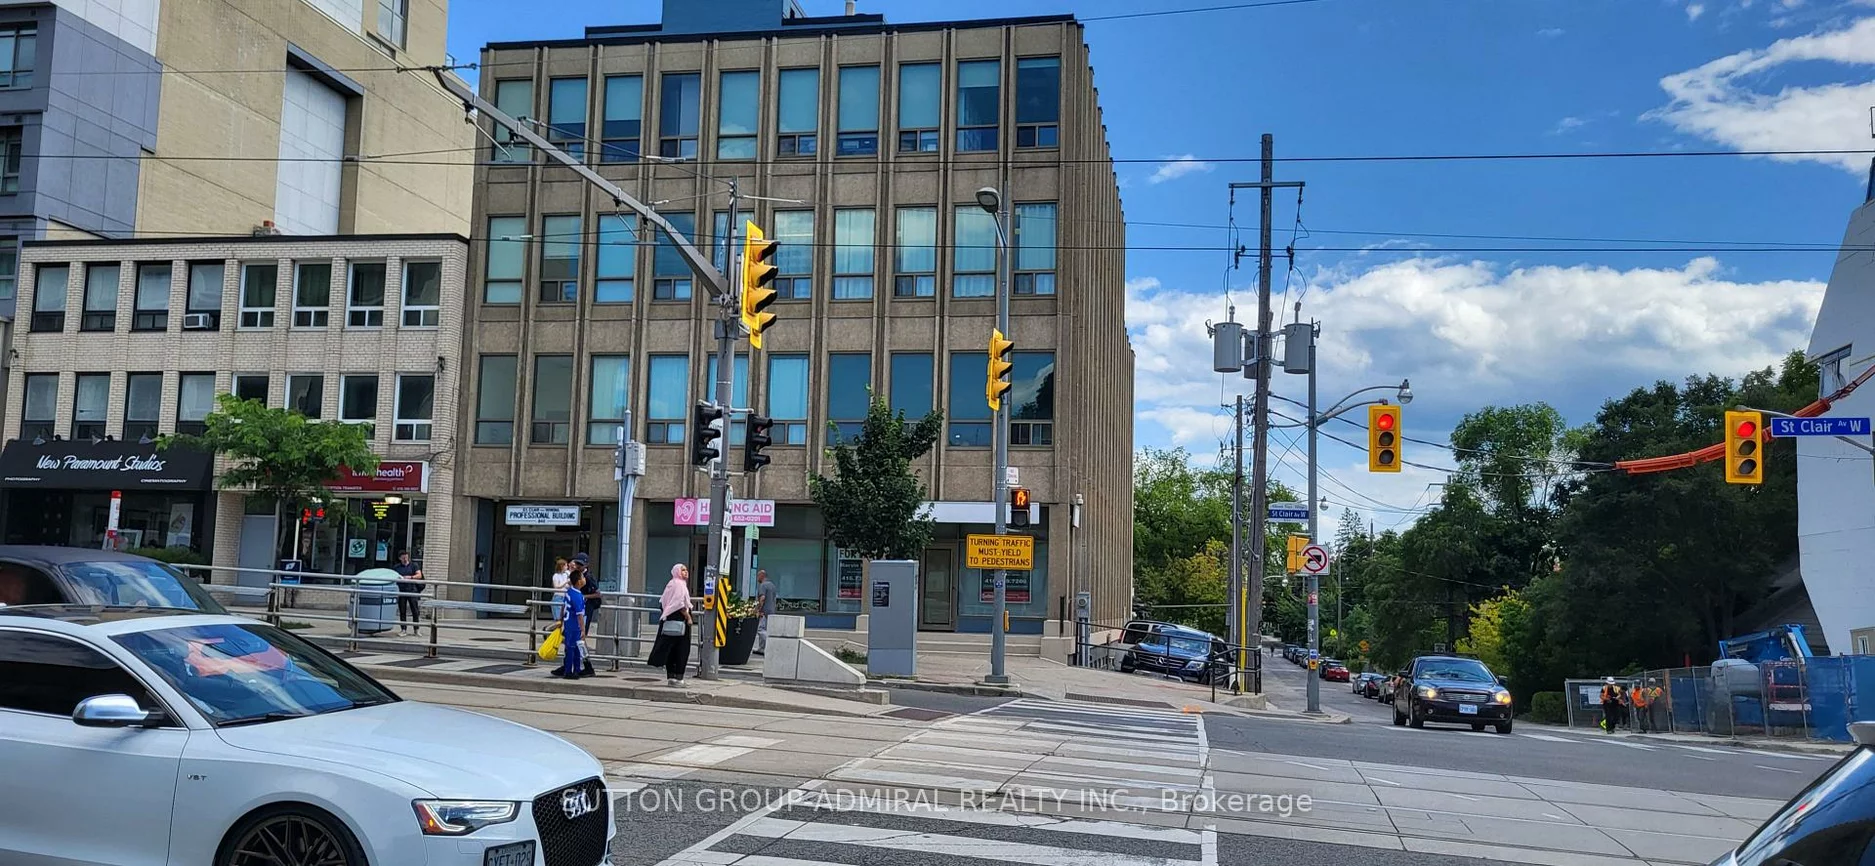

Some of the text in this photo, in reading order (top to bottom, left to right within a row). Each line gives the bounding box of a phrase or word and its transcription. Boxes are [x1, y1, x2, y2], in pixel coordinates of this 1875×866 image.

[1780, 420, 1795, 433] St
[1800, 420, 1833, 433] Clair
[1850, 420, 1862, 432] W
[36, 454, 167, 472] New Paramount Studios
[752, 503, 772, 513] AID
[509, 511, 550, 519] PROFESSIONAL
[970, 538, 1031, 548] TURNING TRAFFIC
[978, 548, 997, 556] MUST
[981, 557, 1030, 566] PEDESTRIANS
